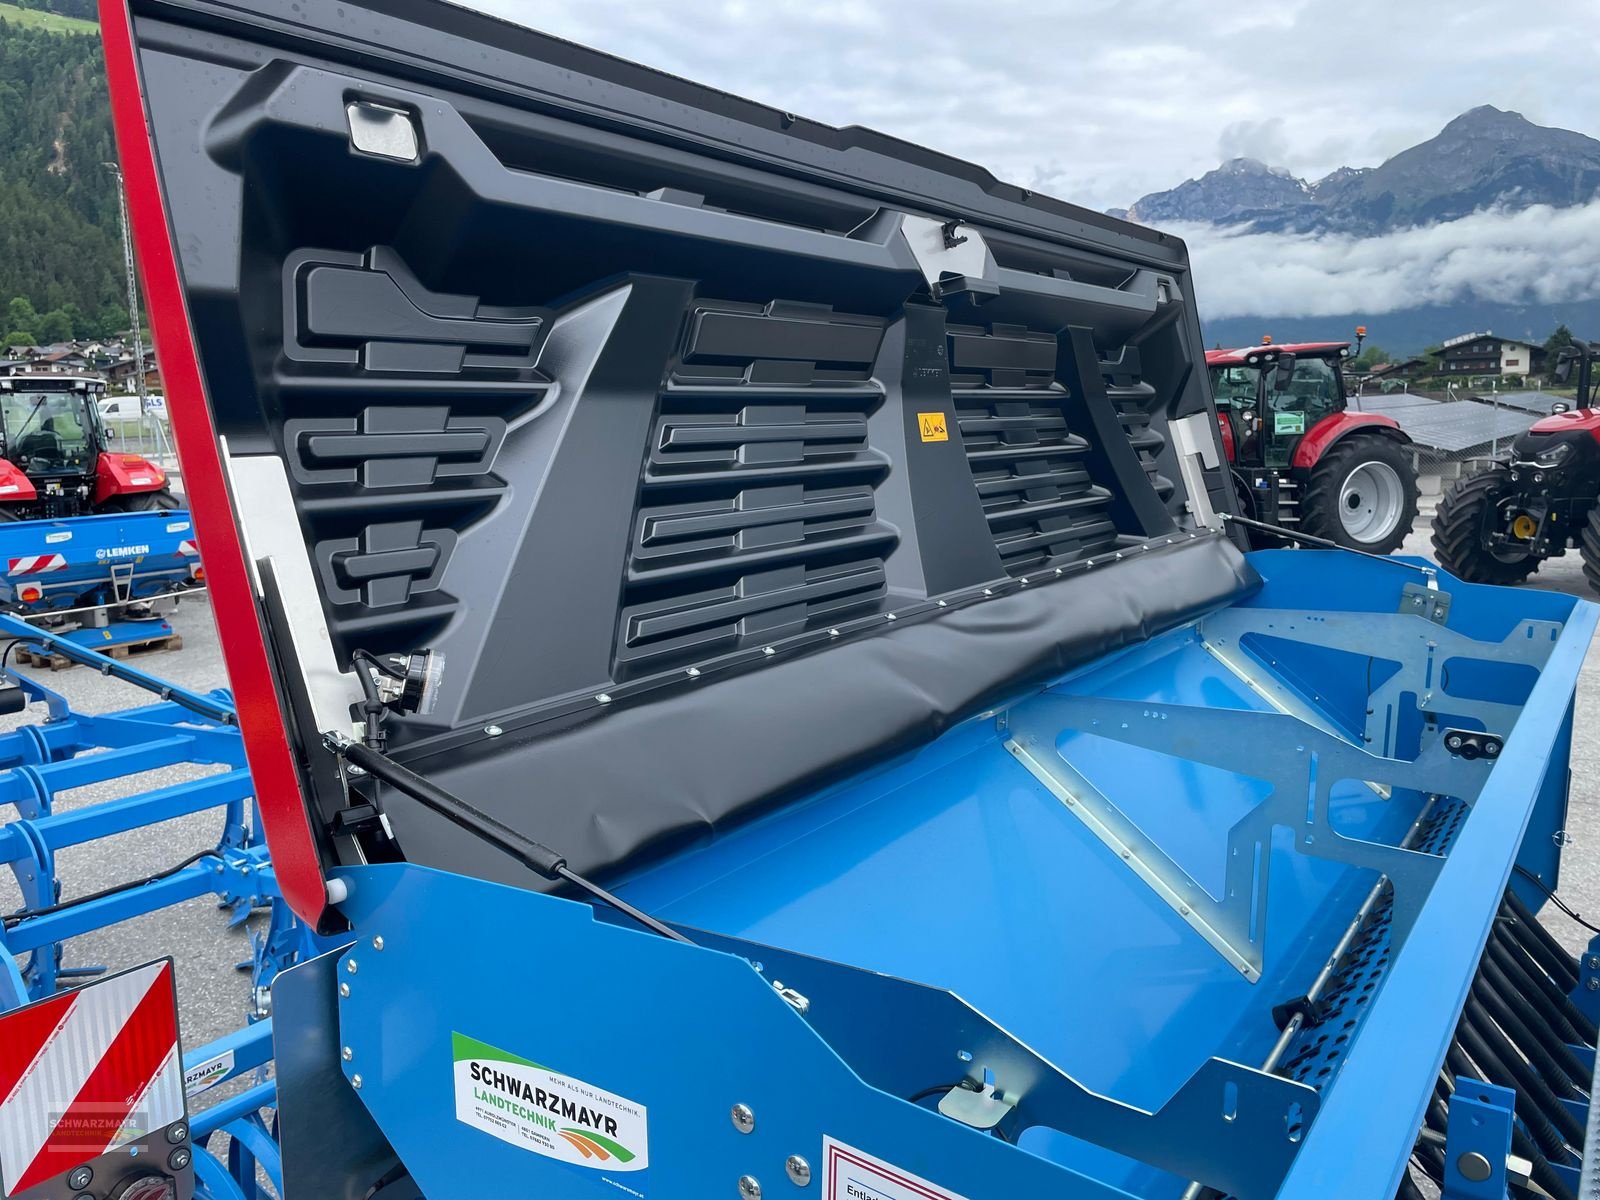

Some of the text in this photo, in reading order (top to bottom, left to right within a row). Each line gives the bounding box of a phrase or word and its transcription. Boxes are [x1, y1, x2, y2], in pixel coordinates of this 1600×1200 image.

[106, 545, 150, 557] LEMKEN
[470, 1061, 618, 1138] SCHWARZMAYR
[549, 1076, 565, 1087] MEHR
[568, 1084, 579, 1092] ALS
[581, 1089, 593, 1097] NUR
[474, 1086, 557, 1132] LANDTECHNIK
